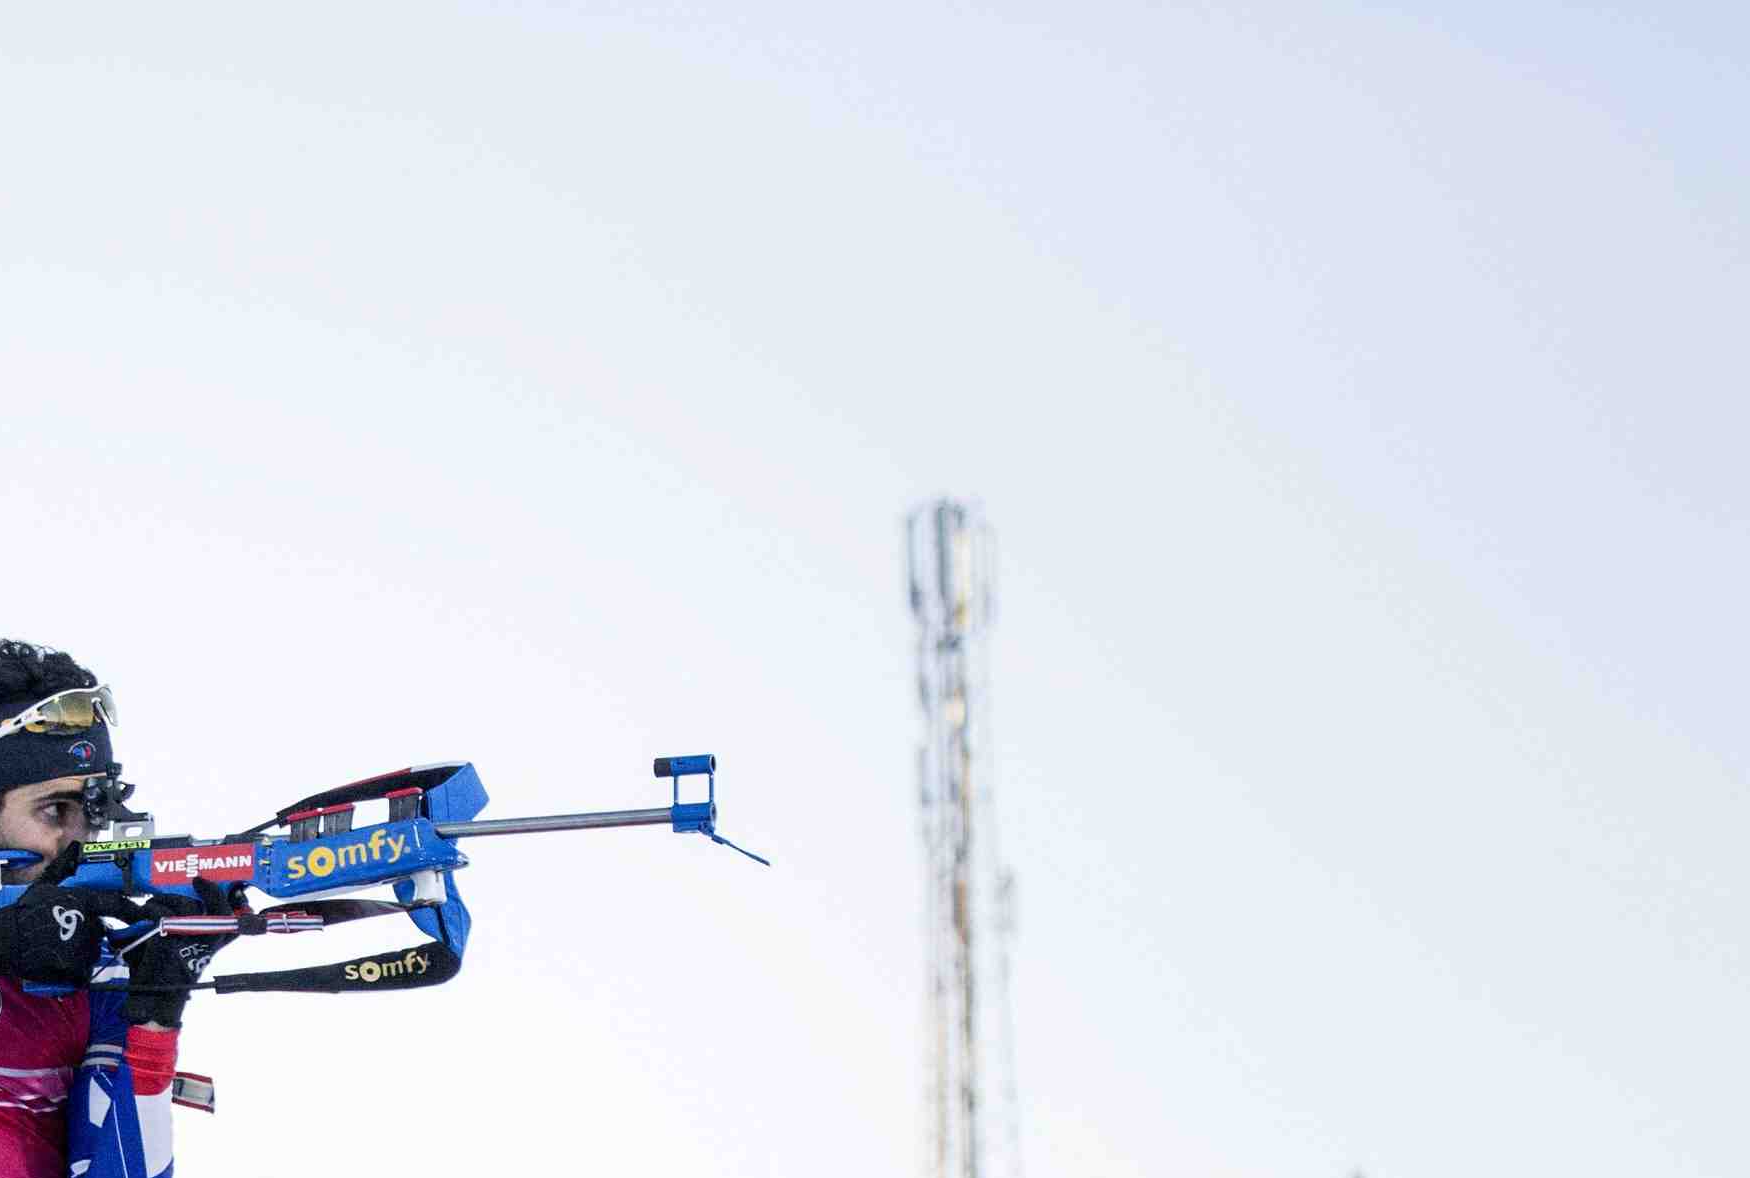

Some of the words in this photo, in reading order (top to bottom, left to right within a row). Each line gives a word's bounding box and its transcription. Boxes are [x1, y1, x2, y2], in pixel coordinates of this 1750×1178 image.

[154, 854, 252, 878] VIESSMANN
[287, 830, 405, 880] somfy
[345, 951, 428, 983] somfy
